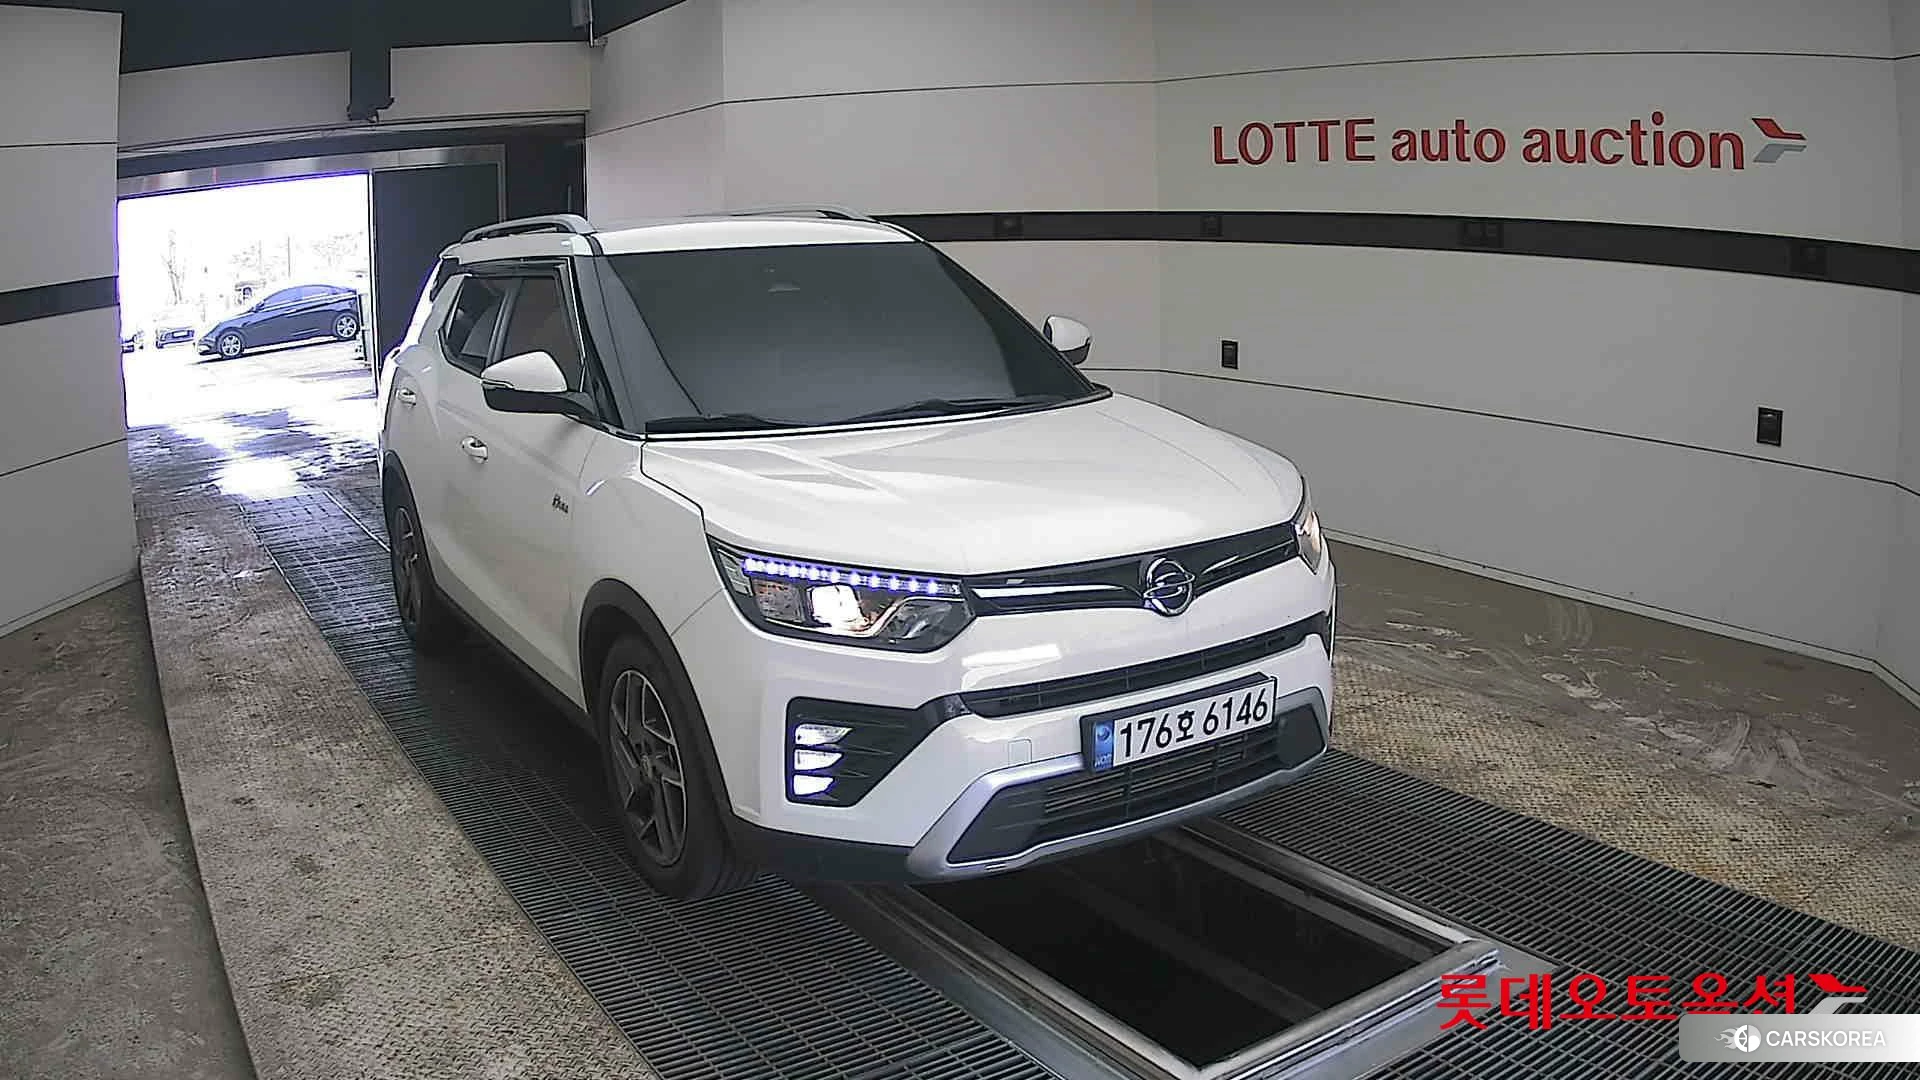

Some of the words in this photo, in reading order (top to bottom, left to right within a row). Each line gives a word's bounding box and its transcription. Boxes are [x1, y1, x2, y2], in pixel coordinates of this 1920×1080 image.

[1212, 118, 1376, 165] LOTTE
[1391, 118, 1506, 164] auto
[1521, 111, 1745, 170] auction
[1120, 710, 1196, 758] 176호
[1202, 687, 1269, 736] 6146
